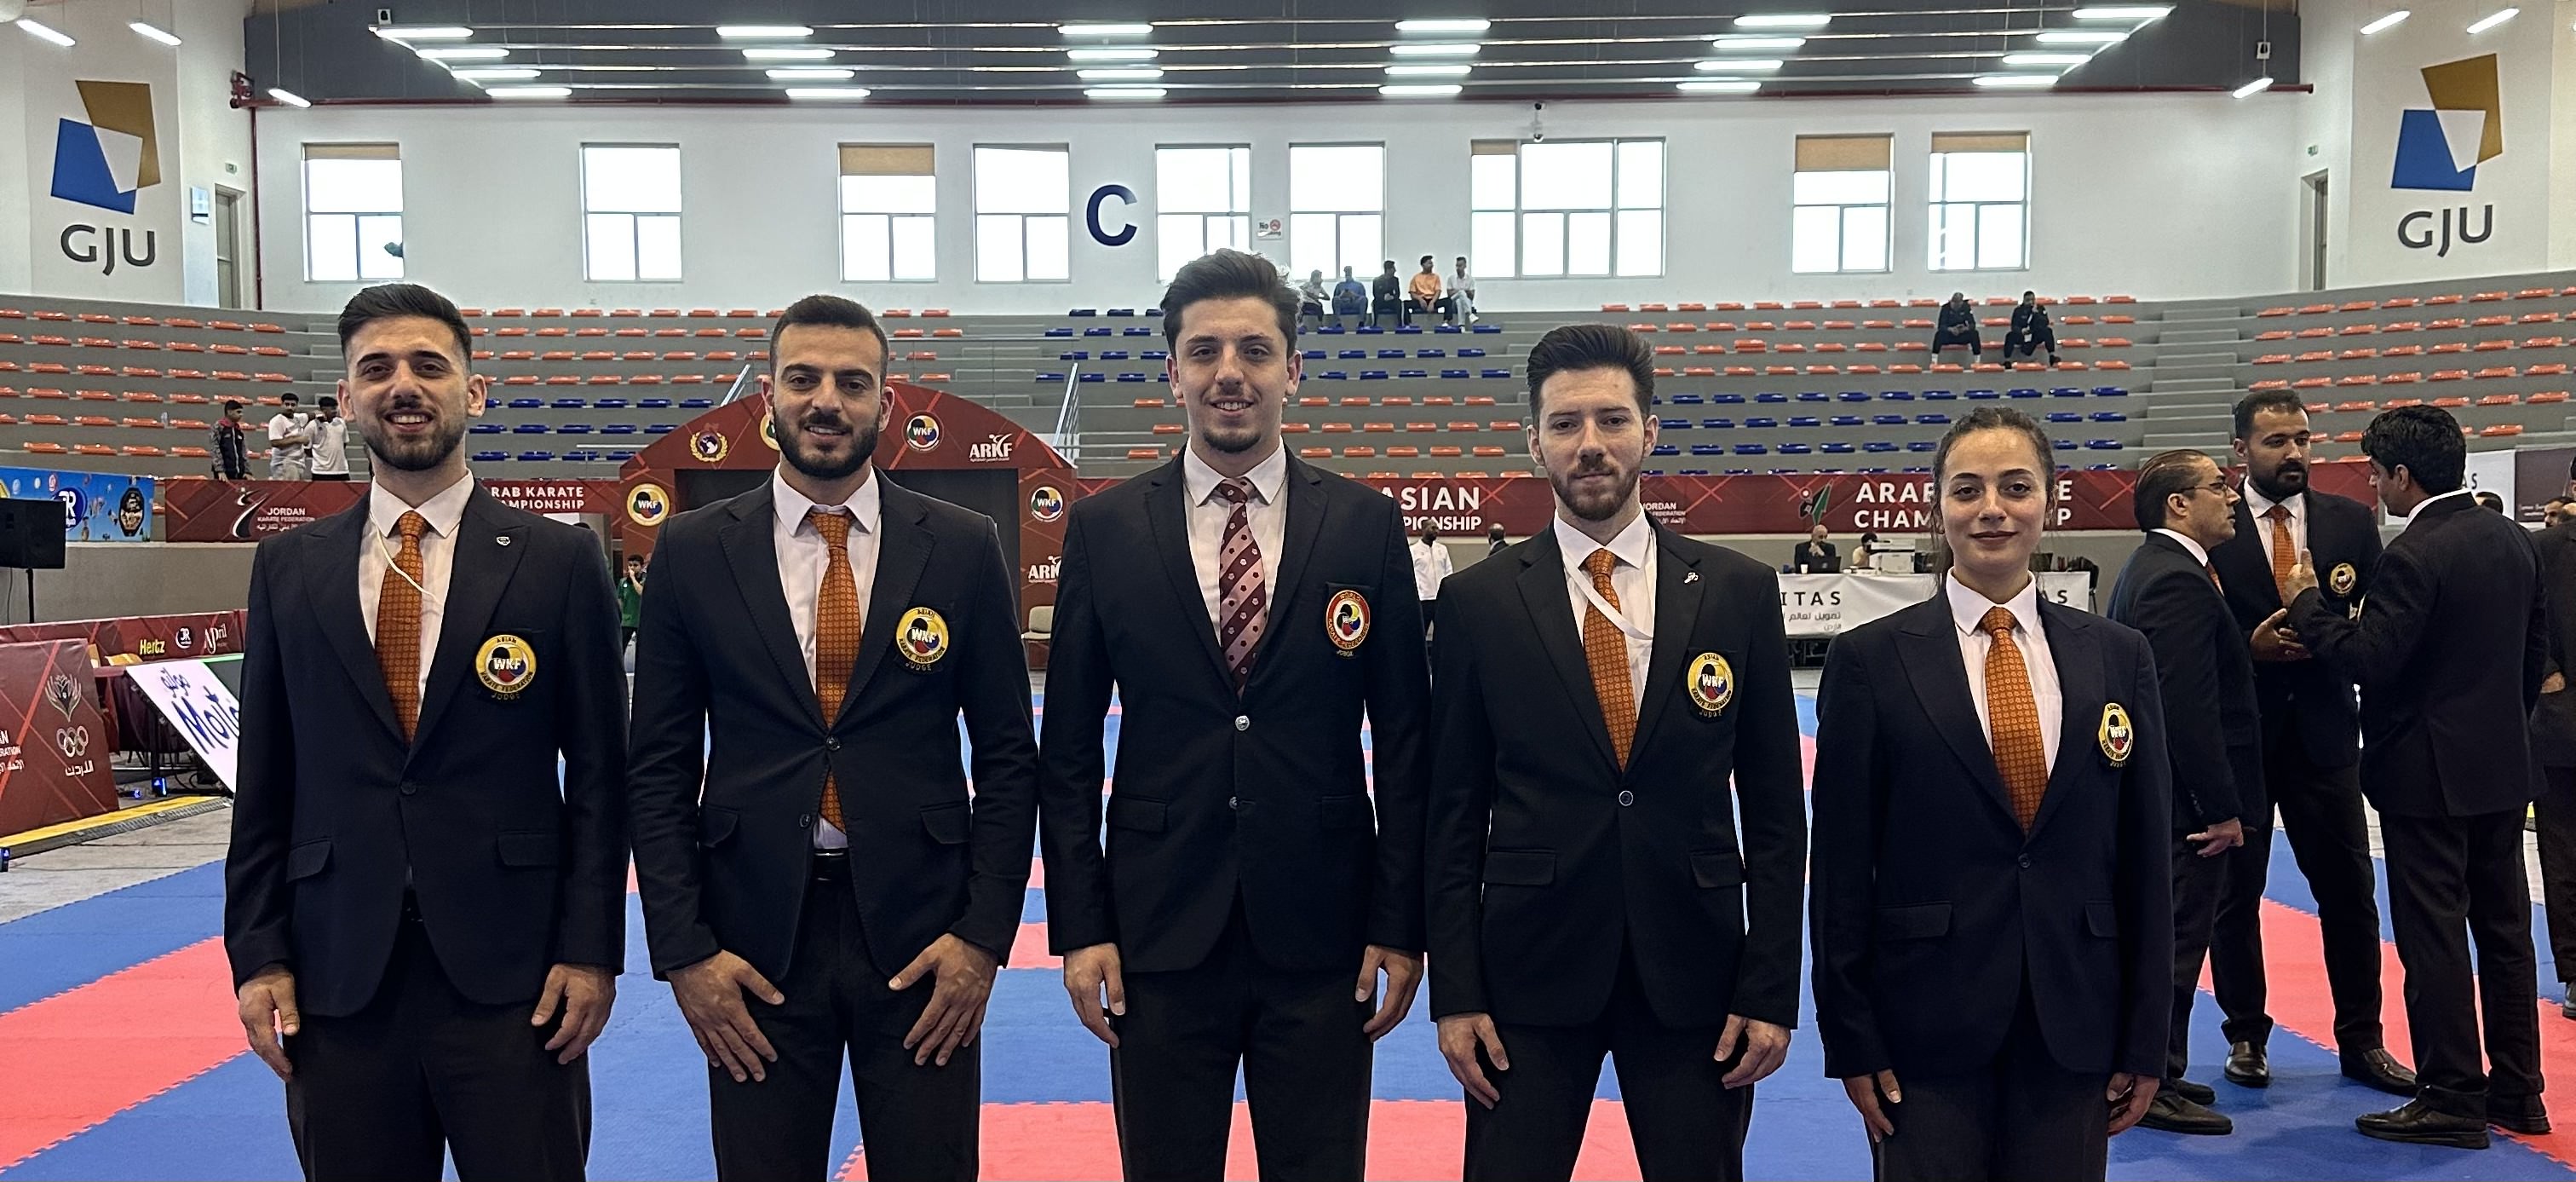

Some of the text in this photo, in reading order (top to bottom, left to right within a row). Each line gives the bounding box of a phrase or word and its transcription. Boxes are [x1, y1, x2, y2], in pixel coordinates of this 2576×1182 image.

[1087, 184, 1137, 246] C
[2398, 205, 2493, 257] GJU
[60, 224, 156, 276] GJU
[912, 427, 934, 436] WKF
[969, 439, 1013, 458] ARKF
[491, 487, 584, 498] RAB KARATE
[502, 499, 585, 510] MPIONSHIP
[637, 499, 658, 509] WKF
[1037, 498, 1058, 508] WKF
[267, 507, 306, 516] JORDAN
[1403, 516, 1482, 531] PINSHIP
[1028, 562, 1060, 579] ARK
[1780, 591, 1841, 606] ITAS
[911, 628, 937, 643] WKF
[140, 638, 165, 654] Hertz
[493, 658, 522, 670] WKF
[1701, 673, 1725, 688] WKF
